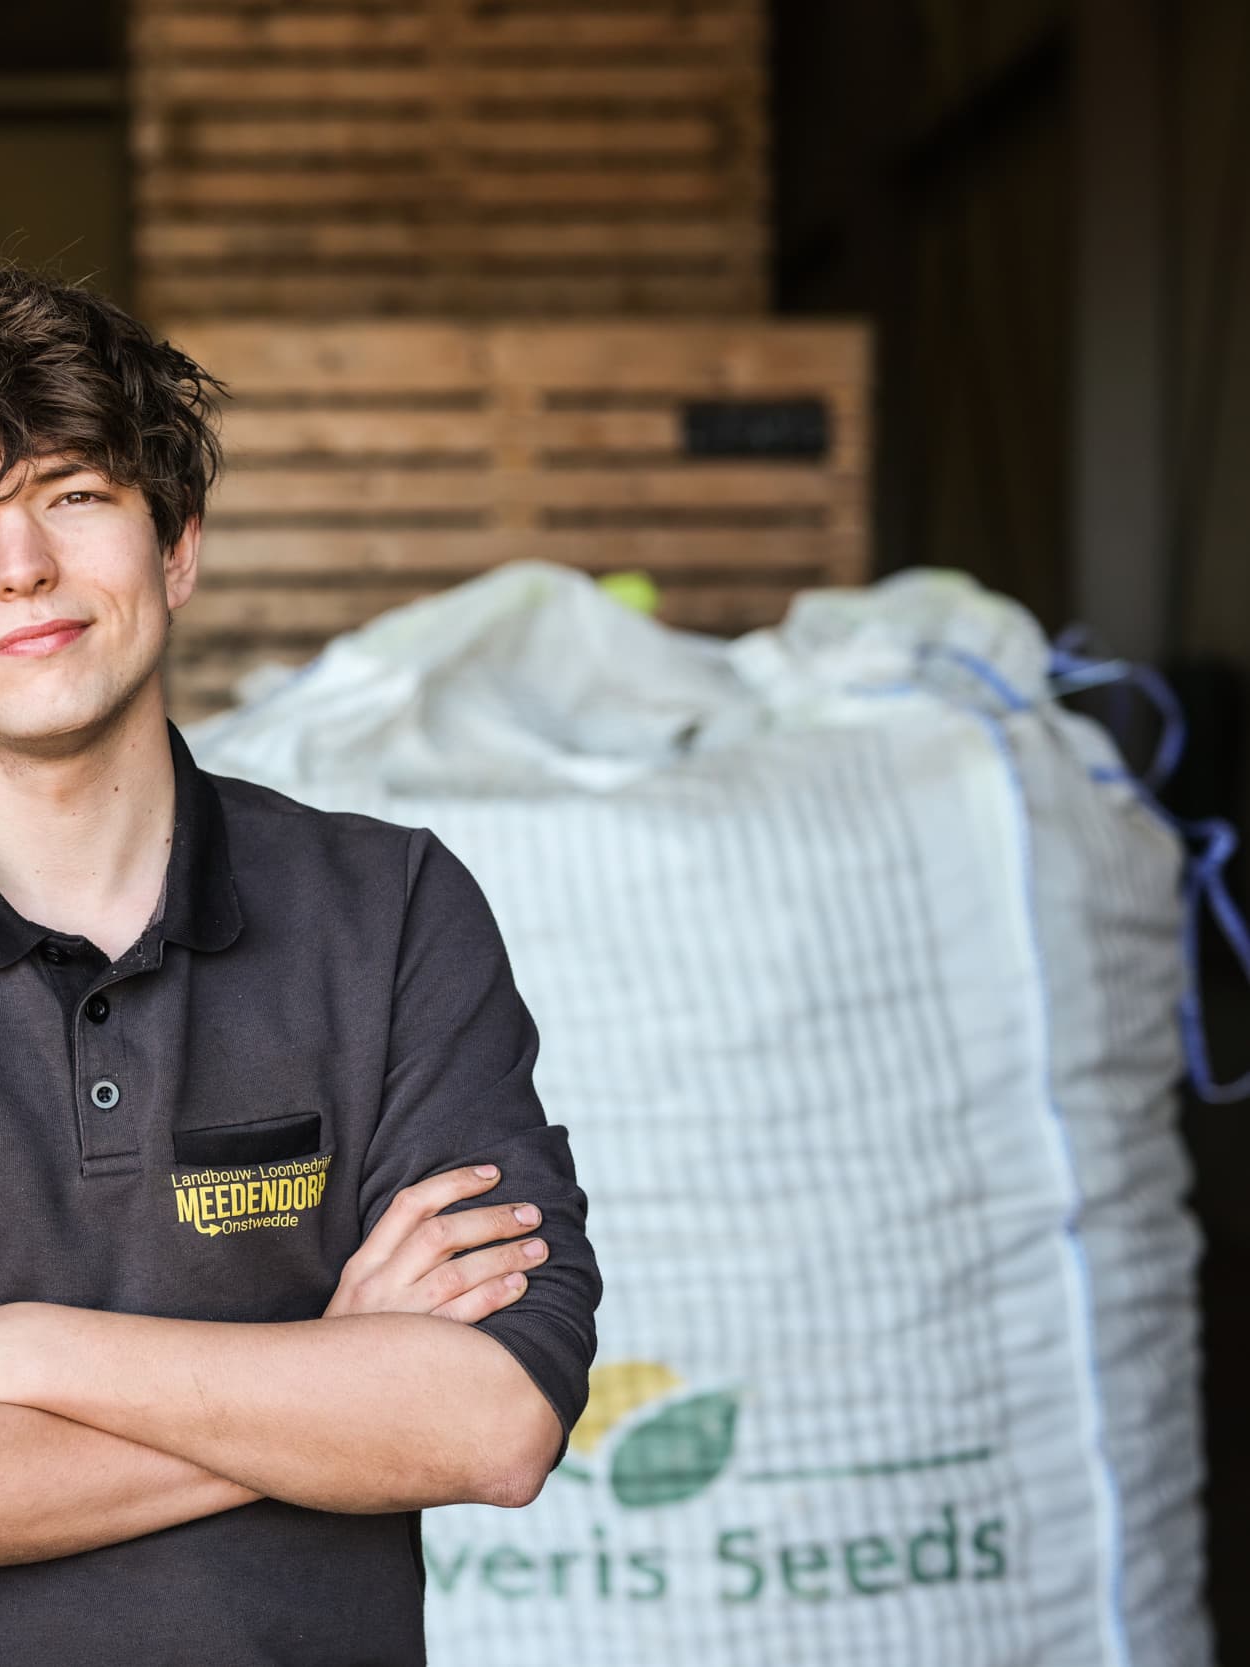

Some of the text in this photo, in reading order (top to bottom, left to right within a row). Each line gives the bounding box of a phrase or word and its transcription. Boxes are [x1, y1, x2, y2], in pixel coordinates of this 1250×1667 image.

[171, 1155, 332, 1188] Landbouw- Loonbedrijf
[175, 1171, 326, 1223] MEEDENDORP
[222, 1213, 299, 1235] Onstwedde
[717, 1500, 1008, 1602] Seeds
